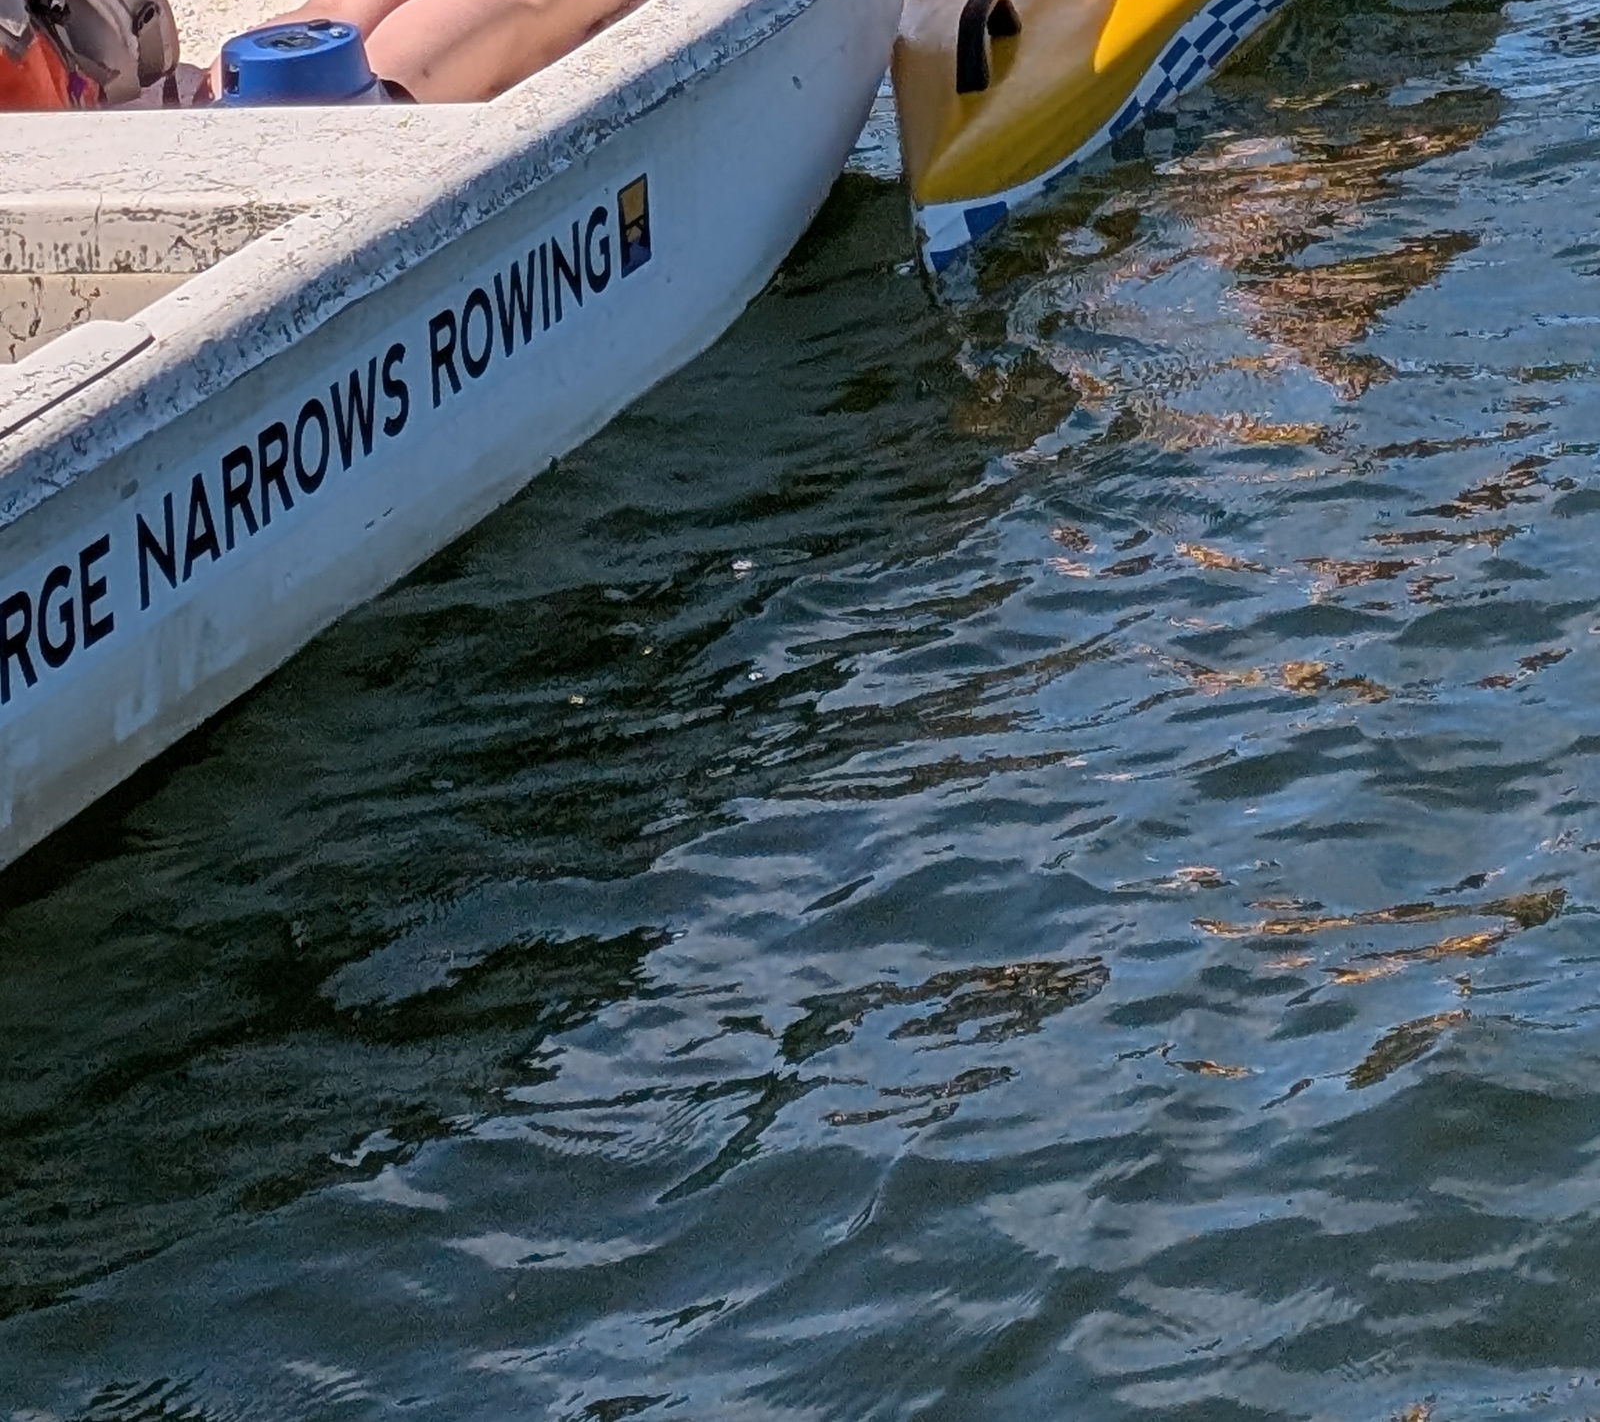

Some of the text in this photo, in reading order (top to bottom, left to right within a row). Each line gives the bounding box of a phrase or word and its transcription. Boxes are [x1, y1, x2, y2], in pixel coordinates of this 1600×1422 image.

[0, 533, 115, 705] RGE
[136, 342, 410, 611] NARROWS
[428, 205, 611, 409] ROWING
